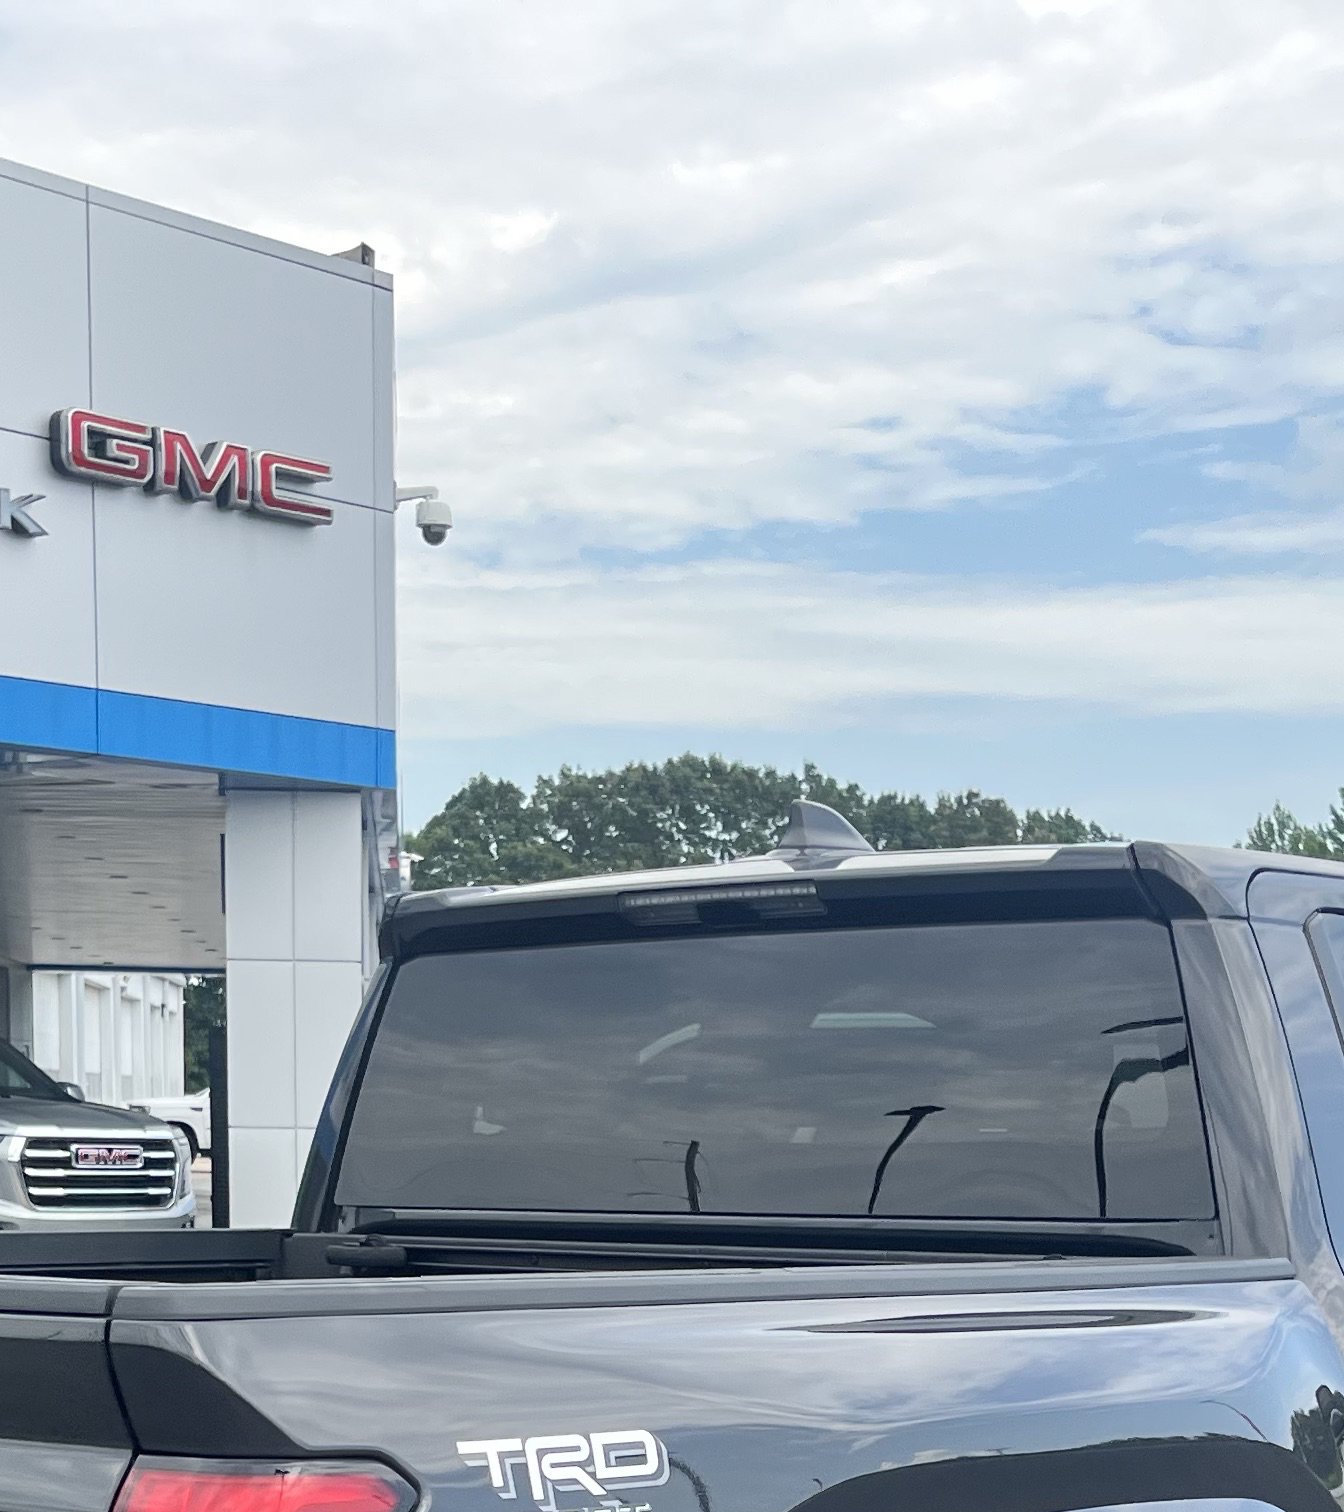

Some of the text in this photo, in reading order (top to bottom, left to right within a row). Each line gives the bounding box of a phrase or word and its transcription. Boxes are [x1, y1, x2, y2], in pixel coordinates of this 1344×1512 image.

[50, 407, 333, 525] GMC
[75, 1147, 143, 1166] GMC
[456, 1430, 668, 1509] TRD
